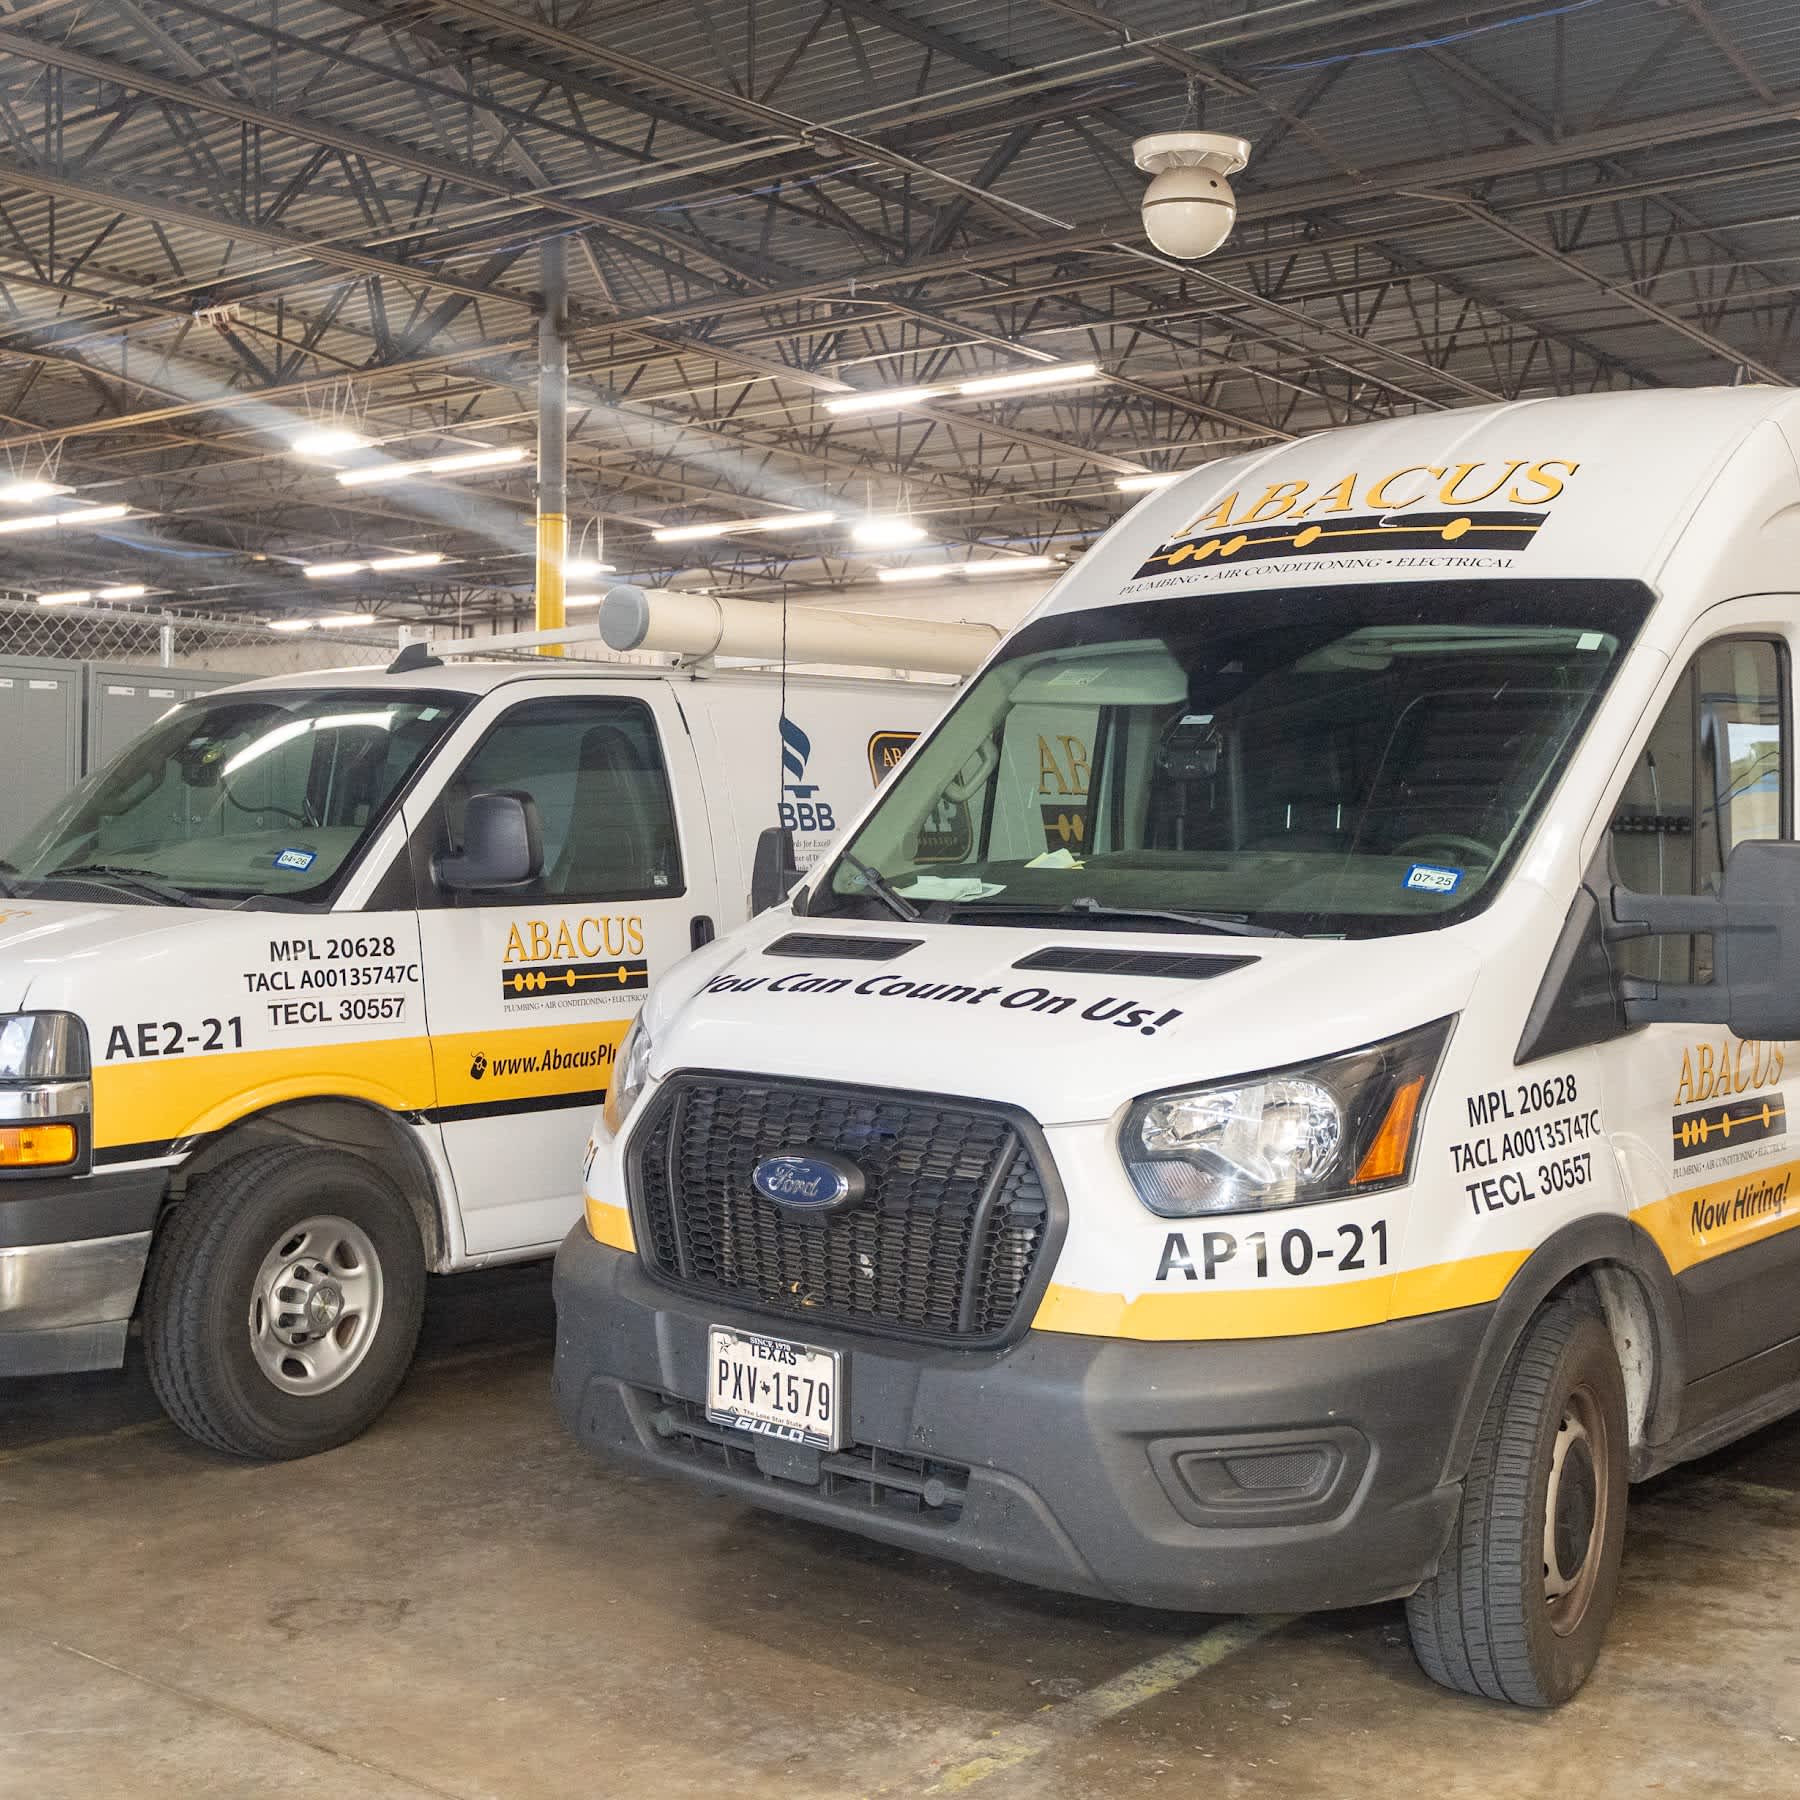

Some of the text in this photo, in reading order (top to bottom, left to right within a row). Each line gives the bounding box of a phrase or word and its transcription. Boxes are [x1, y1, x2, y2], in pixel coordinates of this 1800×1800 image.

[1172, 460, 1580, 538] ABACUS
[1119, 557, 1515, 595] PLUMBING AIR CONDITIONING ELECTRICAL
[777, 803, 836, 831] BBB
[269, 936, 395, 962] MPL 20628
[503, 915, 644, 963] ABACUS
[243, 964, 419, 992] TACL A00135747C
[267, 997, 405, 1026] TECL 30557
[504, 1002, 540, 1013] PLUMBING
[545, 1000, 557, 1009] AIR
[557, 997, 608, 1008] CONDITIONING
[767, 972, 854, 993] Can
[854, 975, 1001, 1004] Count
[999, 988, 1077, 1014] On
[1081, 997, 1183, 1036] Us!
[105, 1016, 243, 1060] AE2-21
[1674, 1040, 1784, 1106] ABACUS
[1467, 1074, 1577, 1127] MPL 20628
[1450, 1109, 1602, 1173] TACL A00135747C
[768, 1164, 821, 1197] Ford
[1465, 1152, 1592, 1215] TECL 30557
[1673, 1163, 1702, 1180] PLUMBING
[1691, 1172, 1791, 1235] Now Hiring!
[1155, 1219, 1387, 1281] AP10-21
[751, 1345, 797, 1366] TEXAS
[719, 1359, 830, 1421] PXV 1579
[735, 1416, 804, 1443] GULLO
